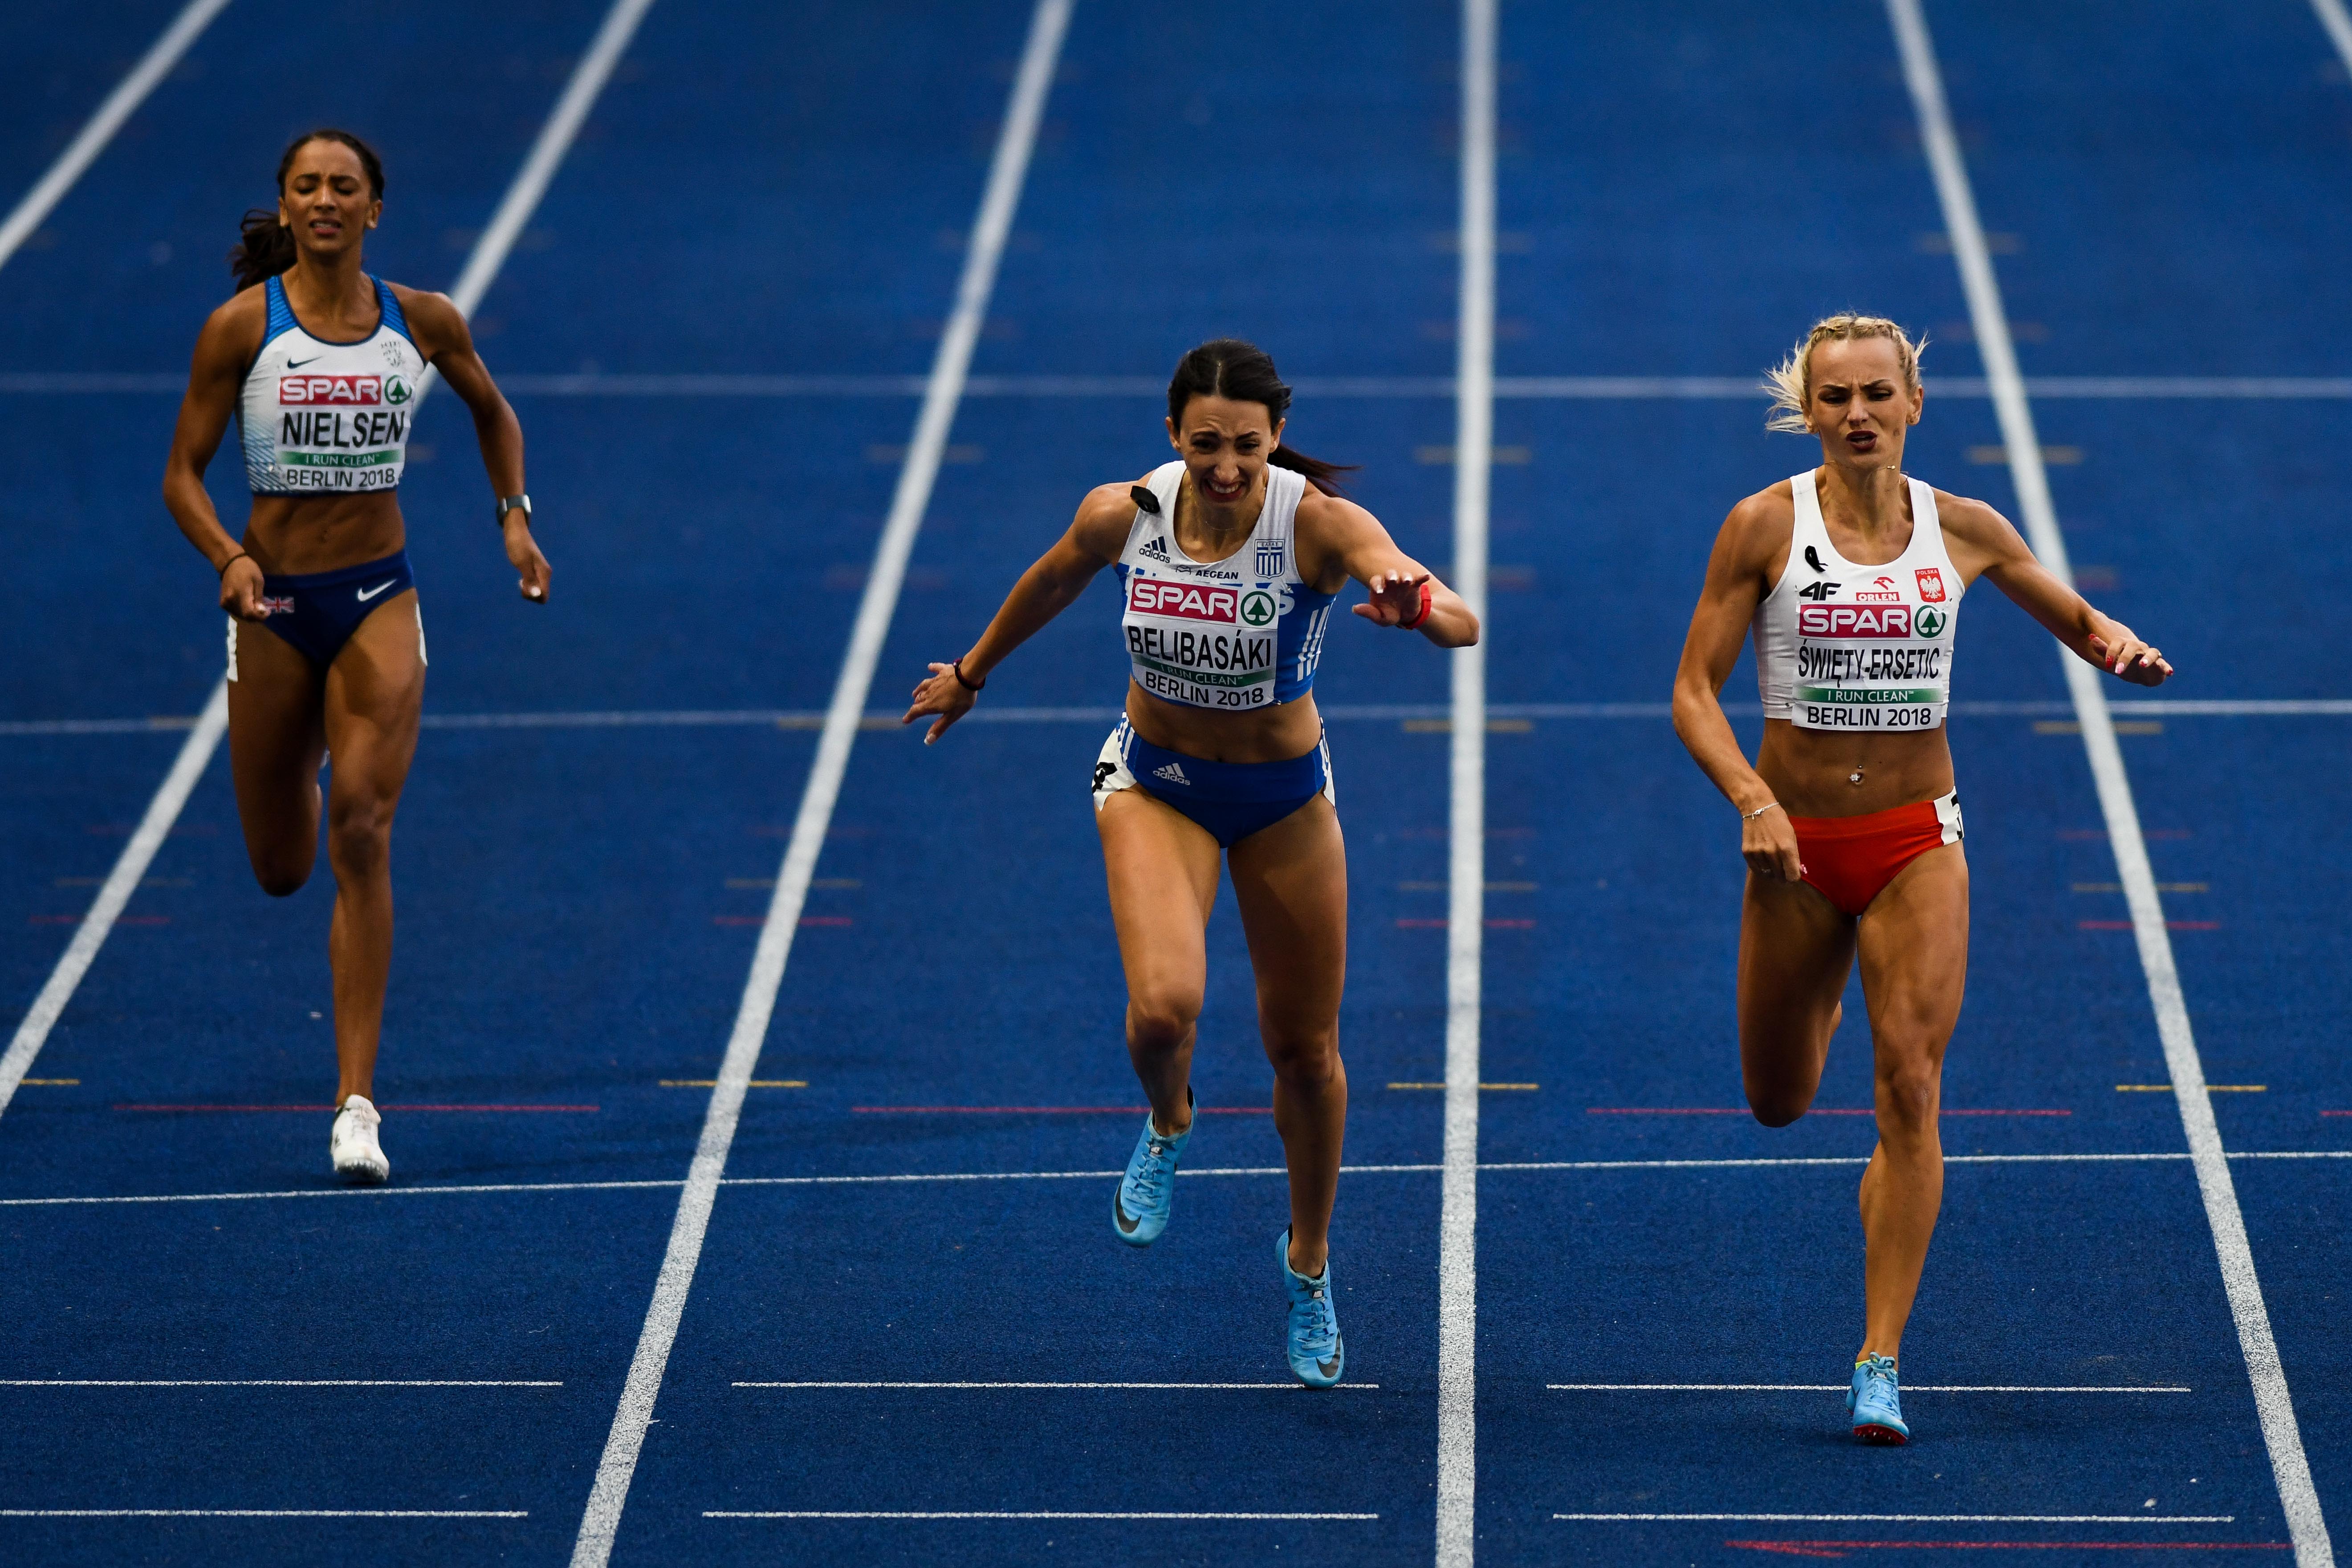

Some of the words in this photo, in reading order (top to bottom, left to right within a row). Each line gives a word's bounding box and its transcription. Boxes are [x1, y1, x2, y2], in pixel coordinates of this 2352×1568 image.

[283, 379, 379, 401] SPAR
[282, 411, 405, 448] NIELSEN
[306, 454, 309, 464] I
[313, 454, 339, 465] RUN
[286, 468, 353, 487] BERLIN
[359, 468, 395, 487] 2018
[1139, 547, 1171, 563] adidas
[1195, 570, 1239, 580] AEGEAN
[1133, 584, 1233, 617] SPAR
[1799, 581, 1842, 601] 4F
[1858, 593, 1897, 601] ORLEN
[1803, 609, 1908, 633] SPAR
[1127, 625, 1271, 671] BELIBASÁKI
[1798, 638, 1940, 688] ŚWIĘTY-ERSETIC
[1168, 668, 1192, 680] RUN
[1146, 671, 1209, 704] BERLIN
[1216, 687, 1264, 707] 2018
[1835, 690, 1864, 702] RUN
[1807, 706, 1880, 726] BERLIN
[1887, 707, 1931, 726] 2018
[1152, 770, 1190, 785] adidas
